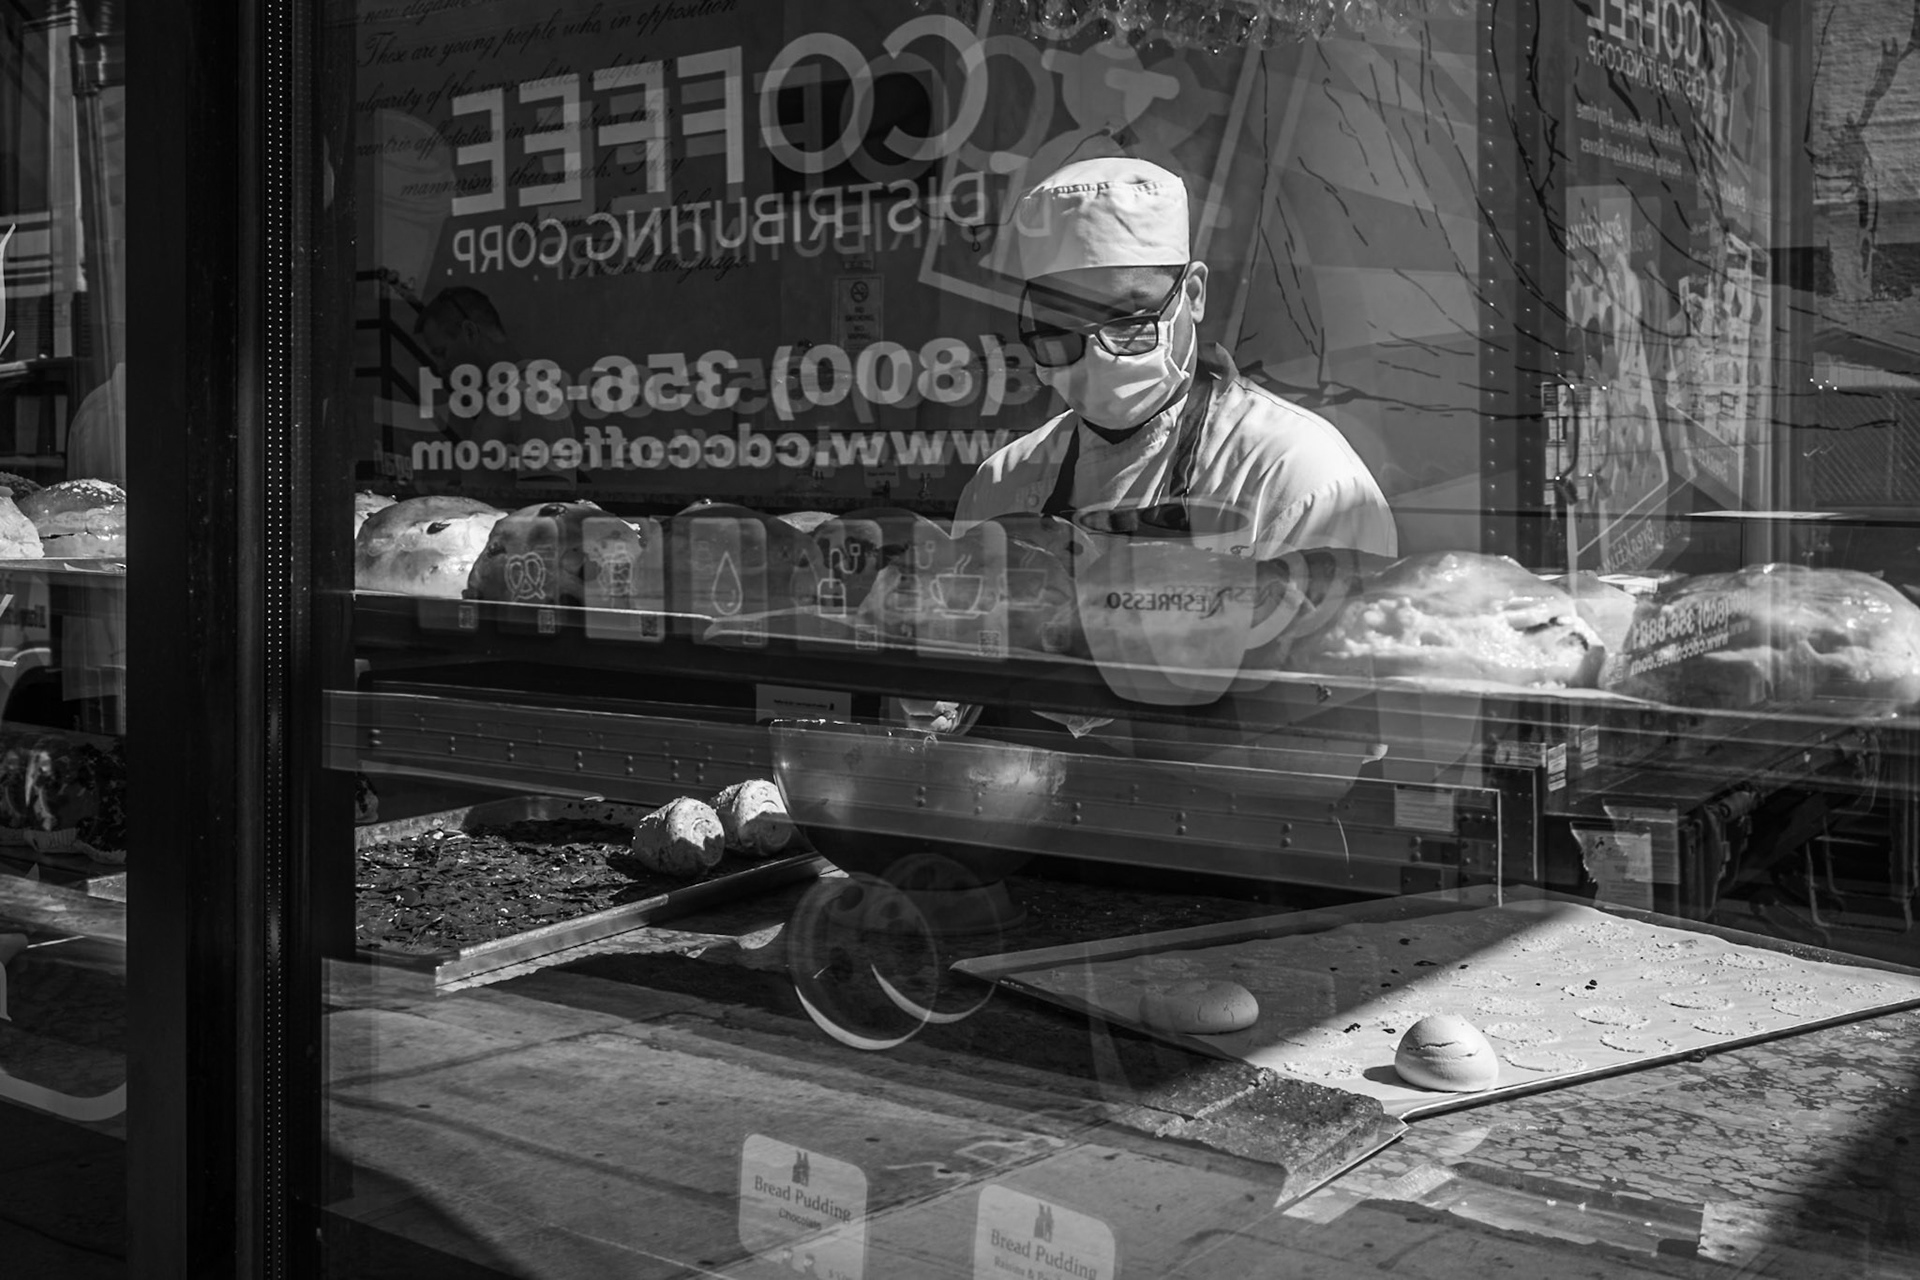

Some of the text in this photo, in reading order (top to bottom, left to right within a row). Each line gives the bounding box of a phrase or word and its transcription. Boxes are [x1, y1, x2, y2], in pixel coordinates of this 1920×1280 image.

[357, 0, 738, 67] These are young people who in opposition
[427, 72, 456, 114] of
[506, 121, 525, 141] in
[754, 1174, 852, 1222] Bread Pudding
[991, 1228, 1098, 1280] Bread Pudding
